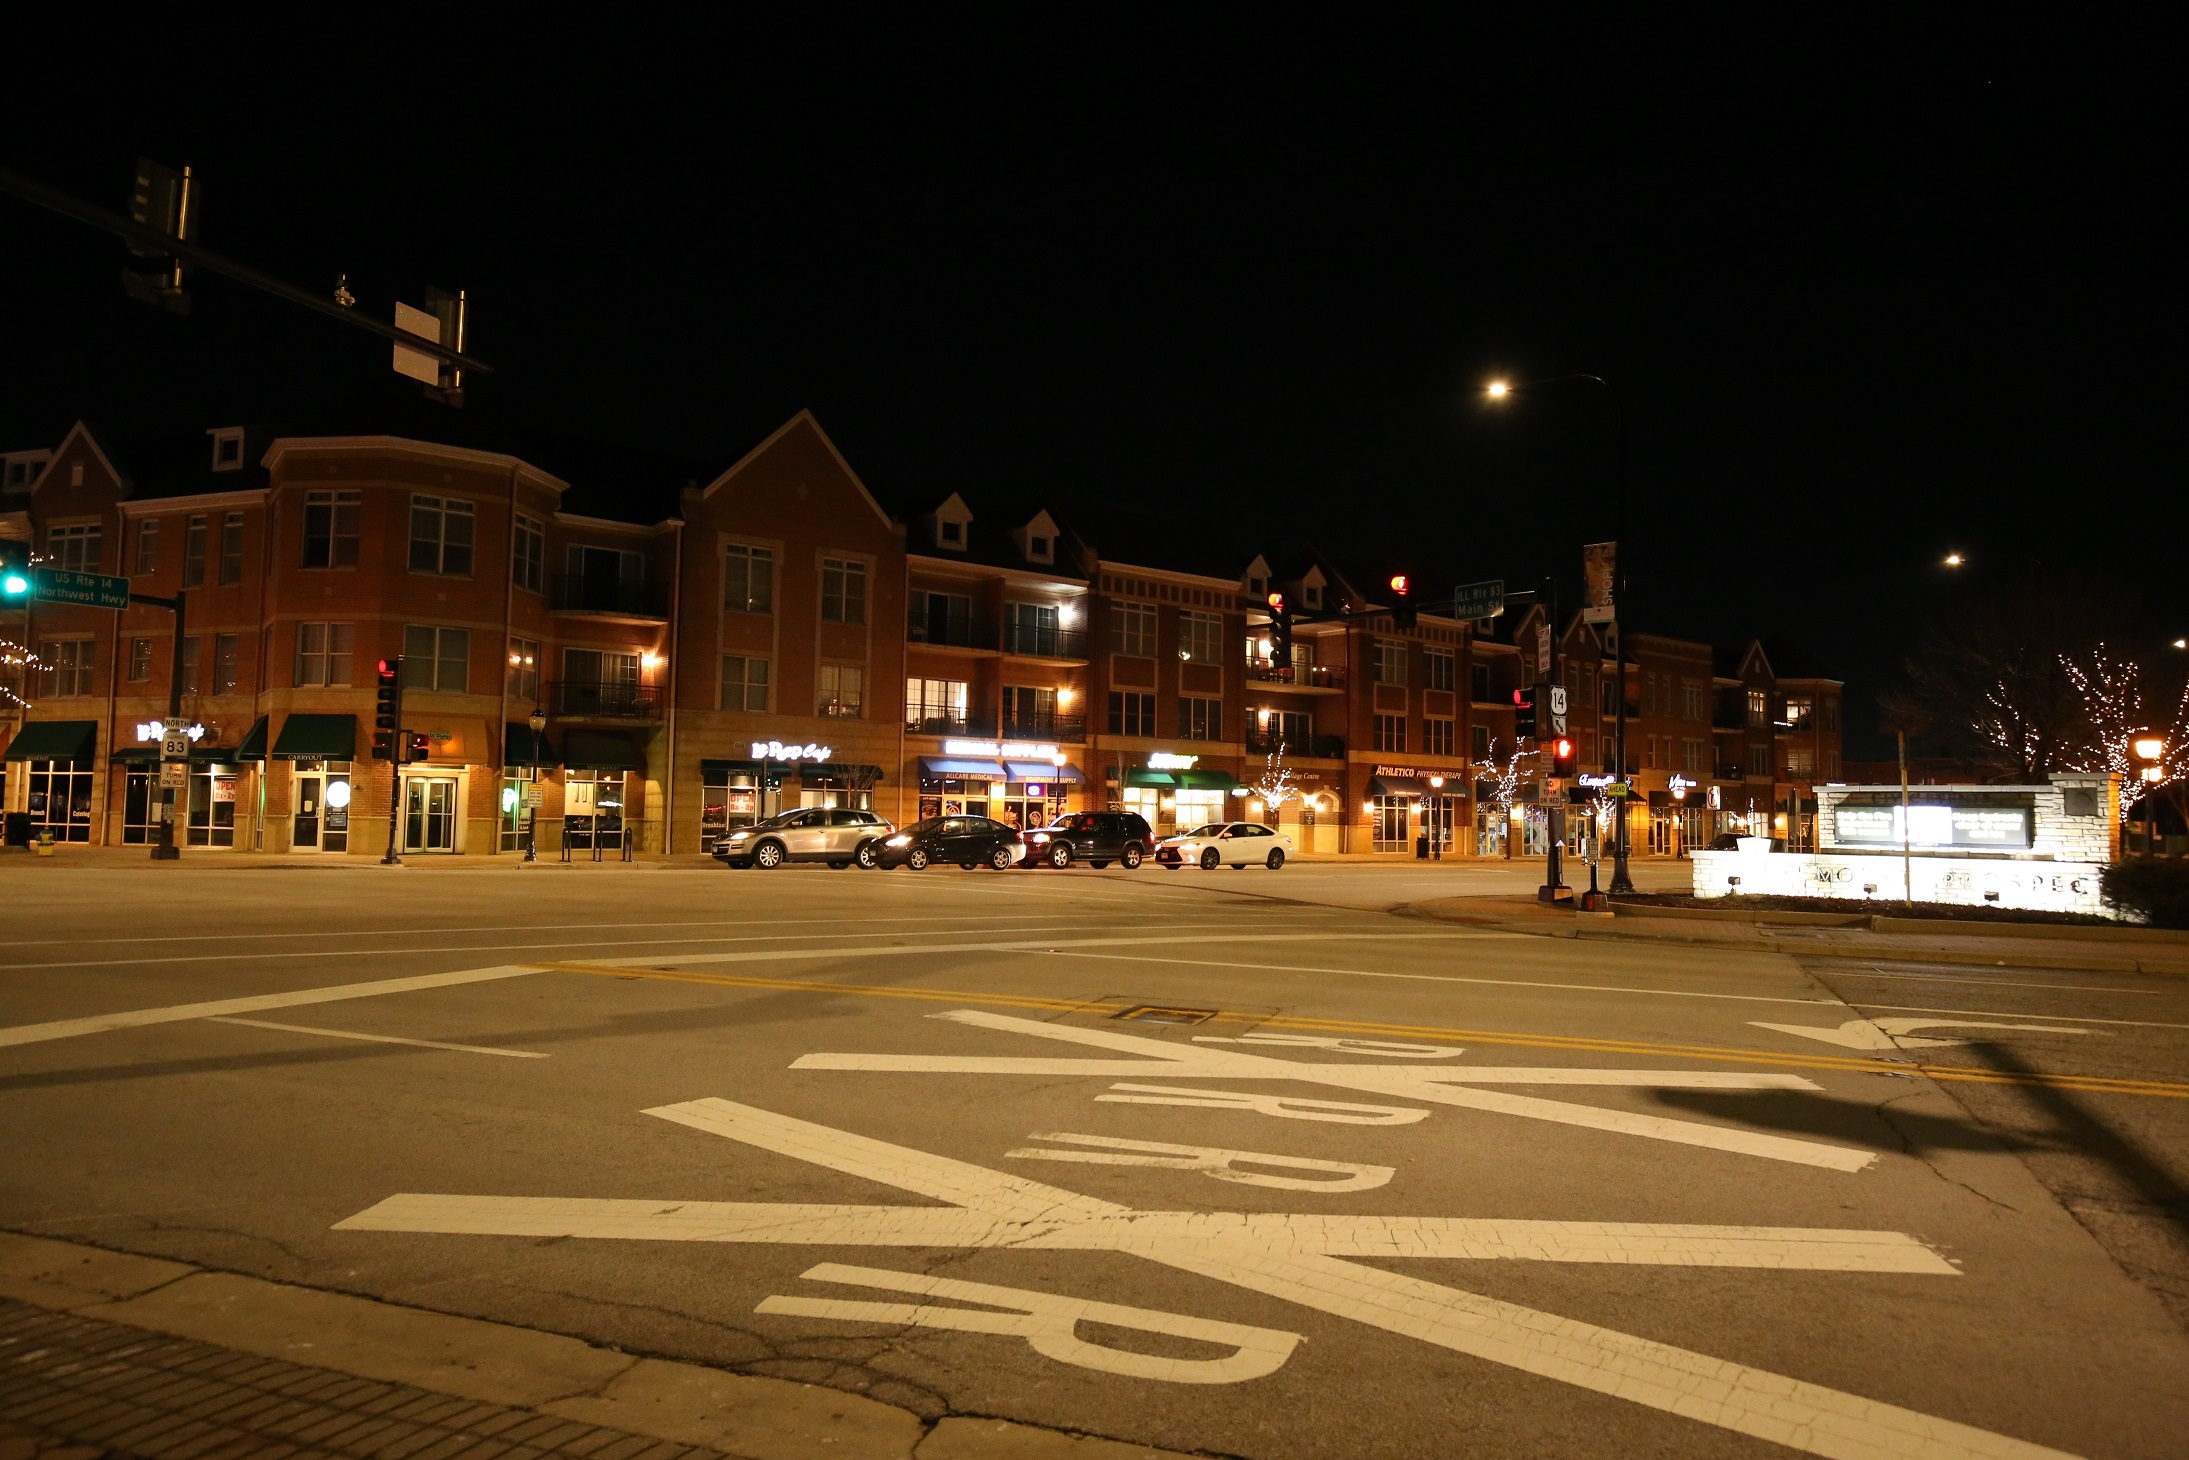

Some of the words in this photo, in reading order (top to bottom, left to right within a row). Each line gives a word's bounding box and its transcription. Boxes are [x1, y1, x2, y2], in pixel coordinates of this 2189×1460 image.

[55, 572, 70, 584] US
[76, 575, 95, 587] Rte
[101, 578, 112, 589] 14
[38, 585, 95, 601] Northwest
[101, 592, 126, 607] Hwy
[1457, 590, 1470, 602] ILL
[1473, 588, 1487, 600] Rte
[1490, 585, 1501, 597] 83
[1458, 603, 1483, 616] Main
[1488, 600, 1500, 612] St
[1553, 692, 1564, 709] 14
[165, 719, 189, 728] NORTH
[166, 741, 185, 753] 83
[1375, 767, 1415, 777] ATHLETICO
[1440, 771, 1462, 780] THERAPY
[215, 781, 236, 791] OPEN
[730, 794, 755, 802] OPEN
[730, 803, 739, 811] 8a
[745, 804, 754, 812] 2p
